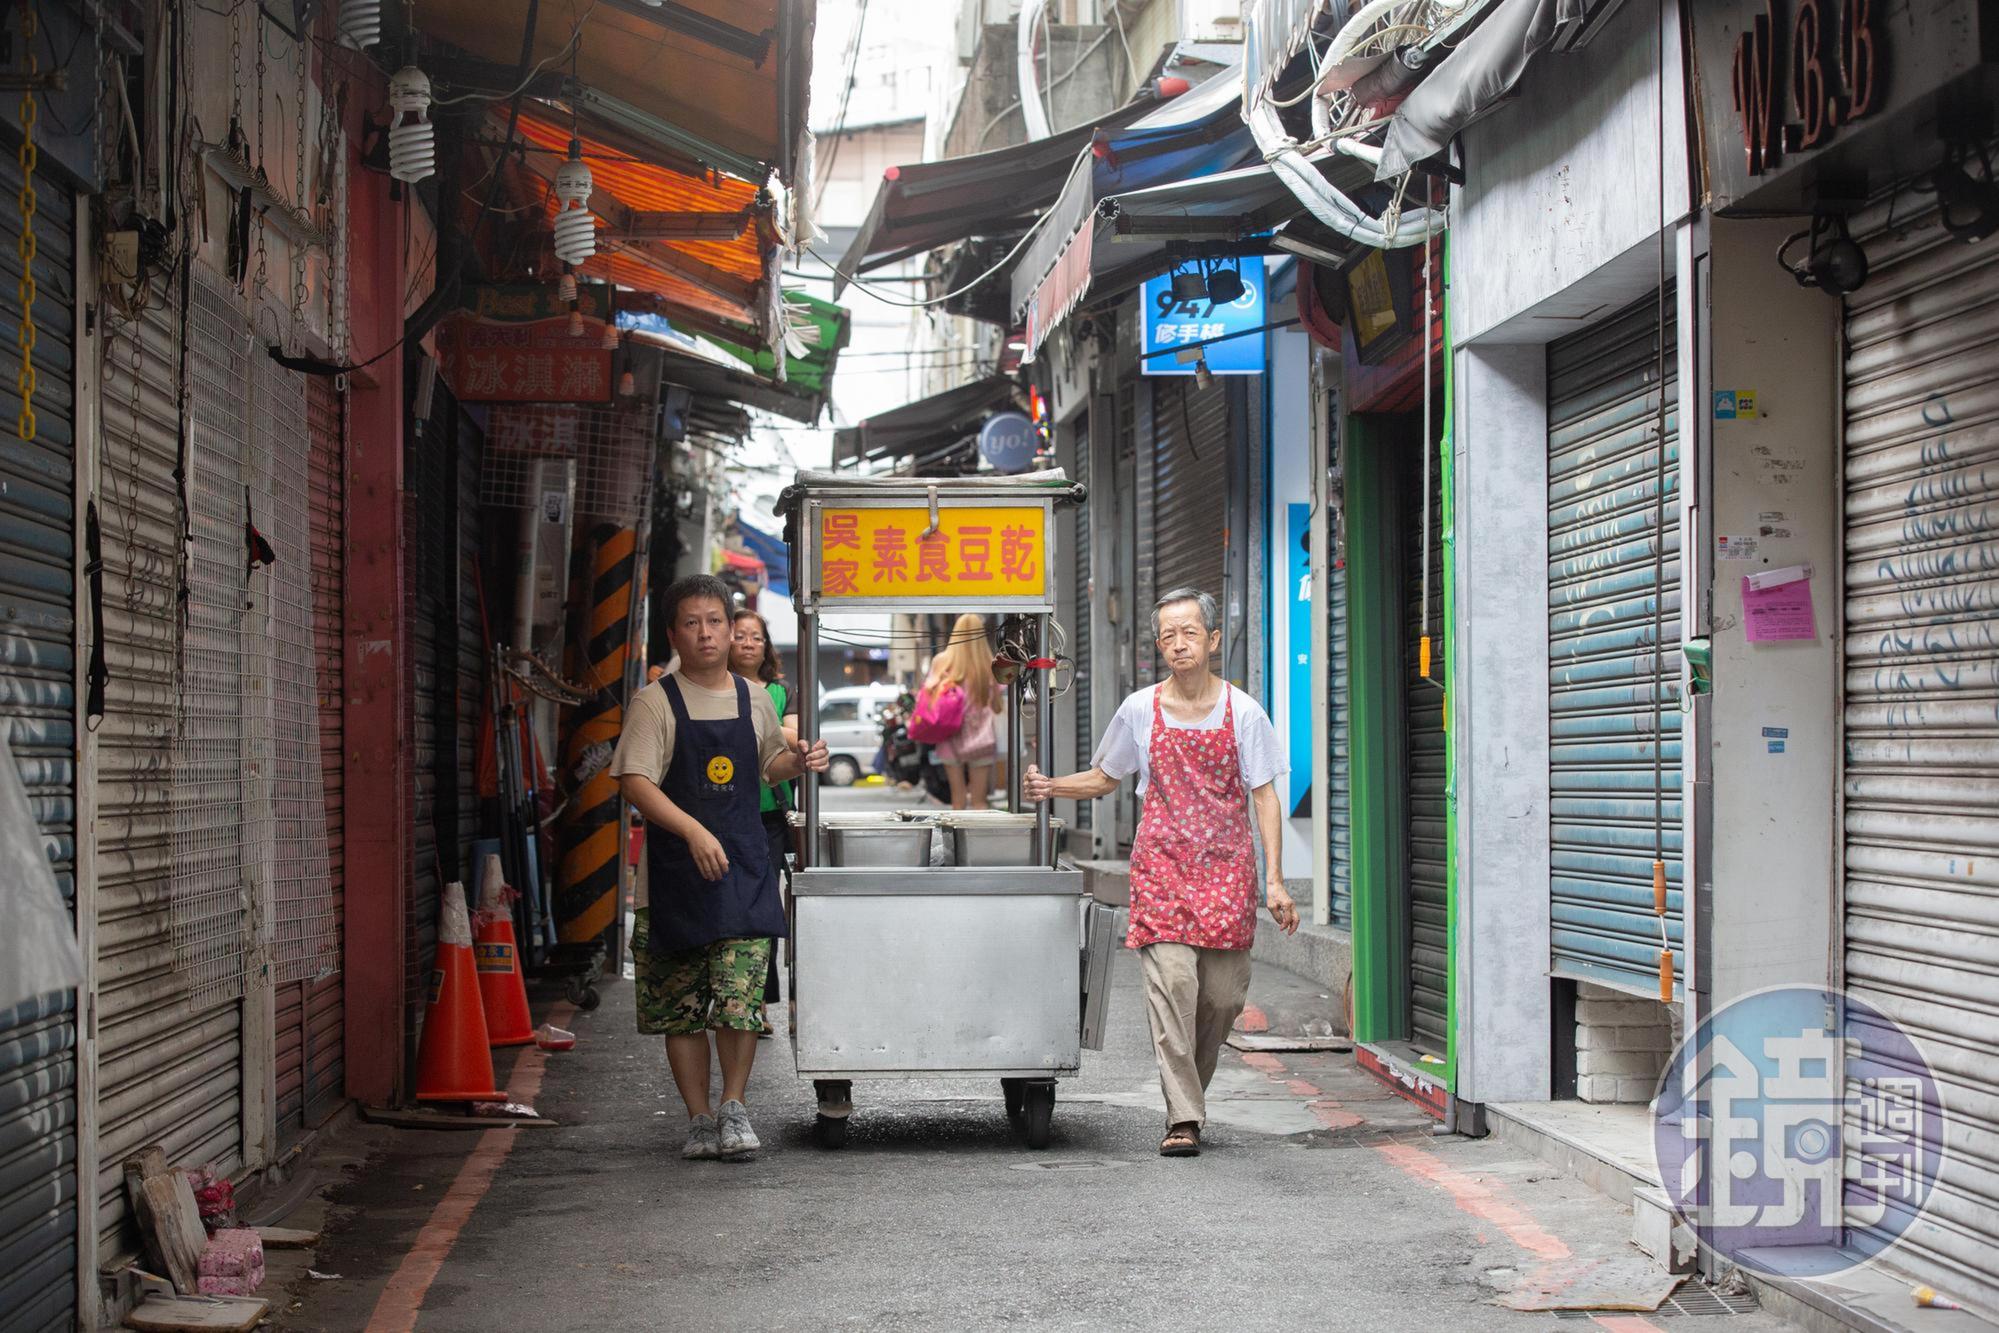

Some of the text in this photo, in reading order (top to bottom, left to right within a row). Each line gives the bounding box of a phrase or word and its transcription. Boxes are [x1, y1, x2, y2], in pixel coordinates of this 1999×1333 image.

[465, 353, 602, 396] 冰淇淋
[823, 514, 861, 594] 吳家
[872, 524, 1036, 583] 素食豆乾
